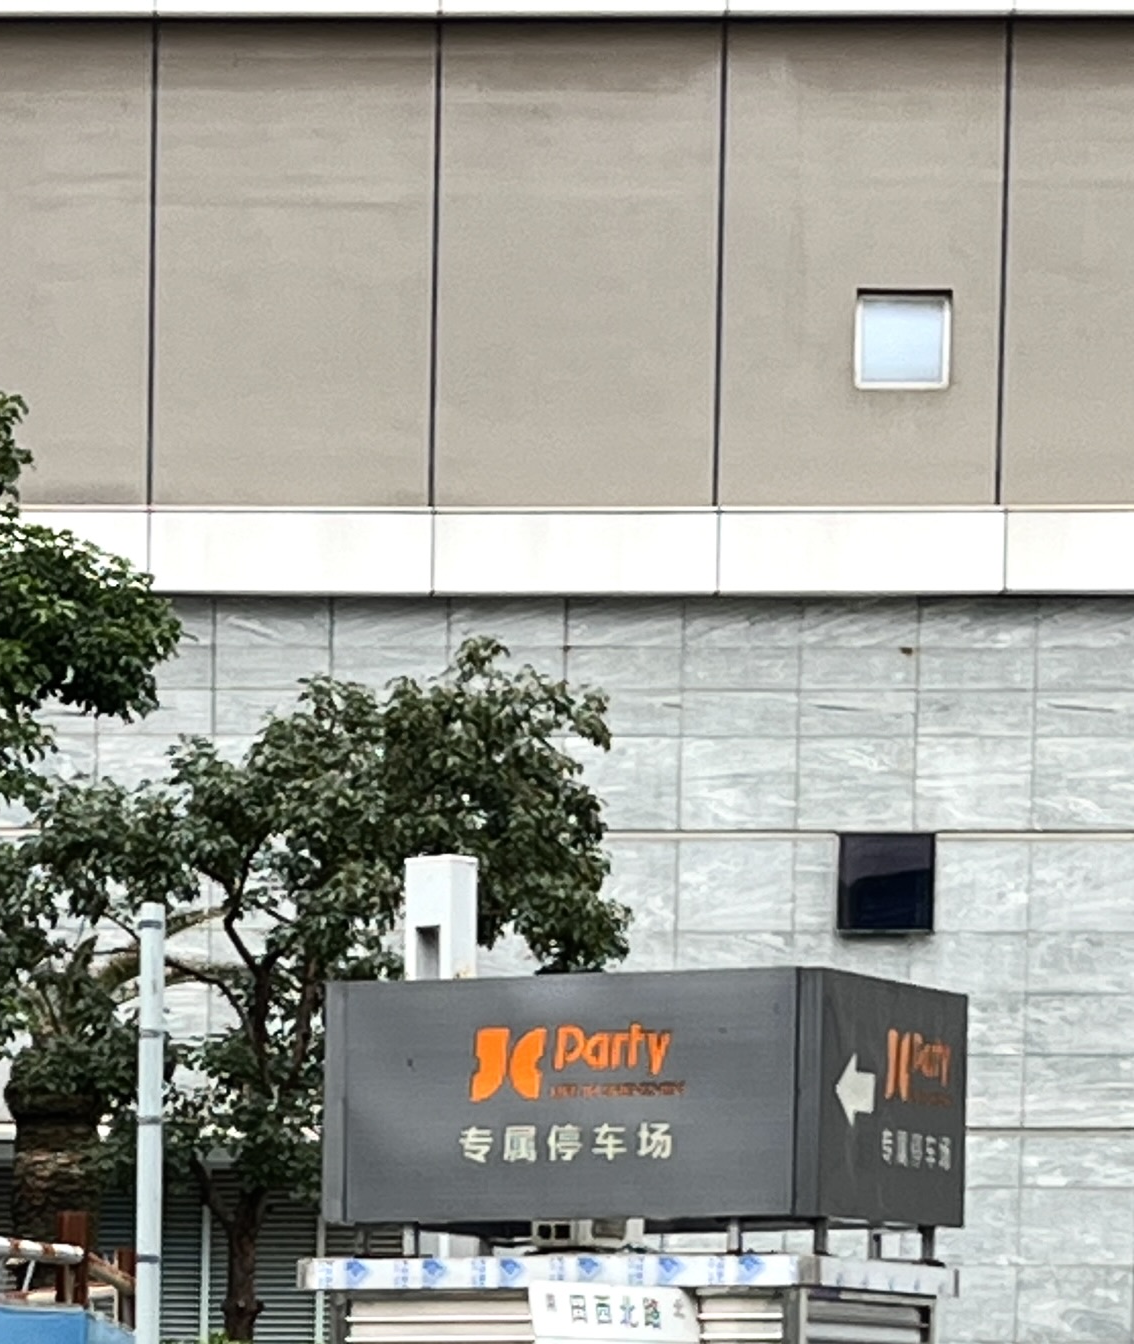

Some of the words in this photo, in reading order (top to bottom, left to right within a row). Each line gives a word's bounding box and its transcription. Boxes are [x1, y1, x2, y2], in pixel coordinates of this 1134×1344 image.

[459, 1121, 673, 1164] 专属停车场
